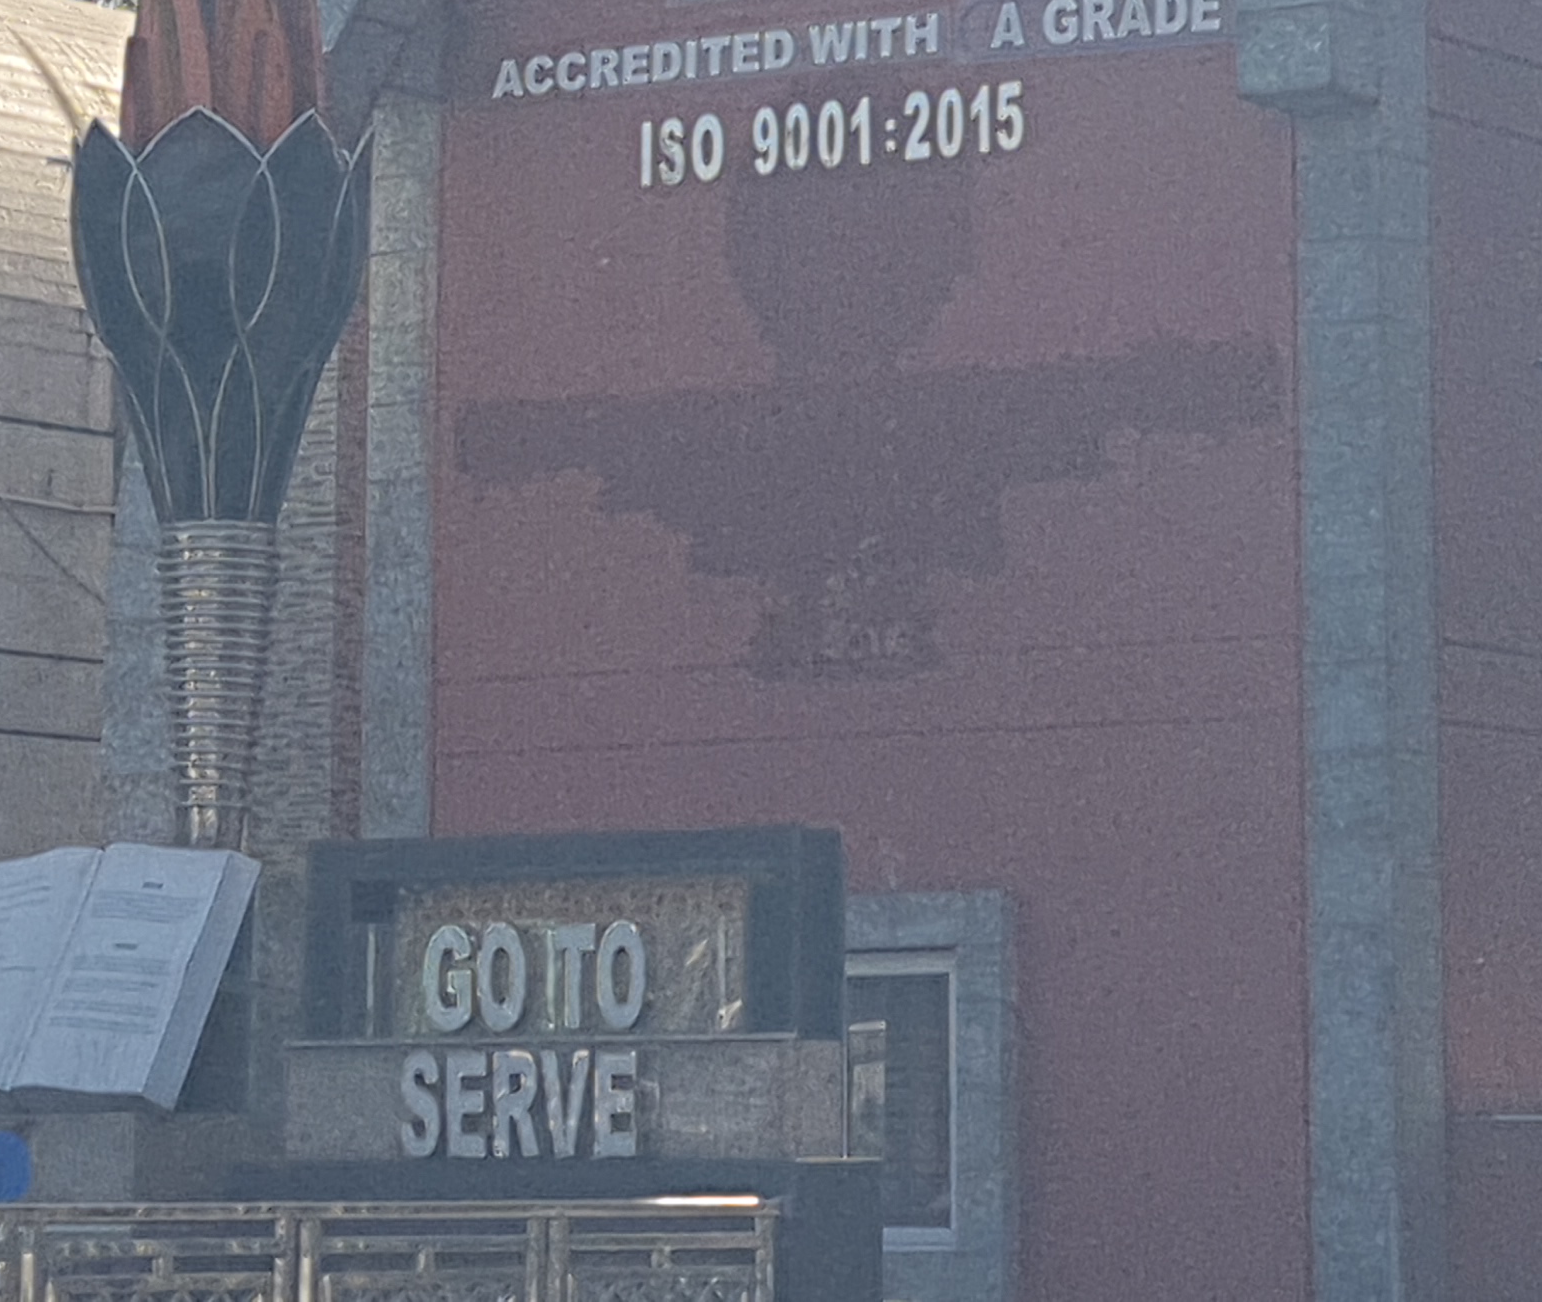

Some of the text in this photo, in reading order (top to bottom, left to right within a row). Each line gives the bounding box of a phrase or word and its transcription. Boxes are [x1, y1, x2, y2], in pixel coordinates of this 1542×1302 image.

[492, 27, 795, 100] ACCREDITED
[809, 13, 940, 65] WITH
[990, 1, 1026, 50] A
[640, 80, 1026, 189] ISO 9001:2015
[422, 918, 647, 1033] GO TO
[399, 1048, 638, 1159] SERVE
